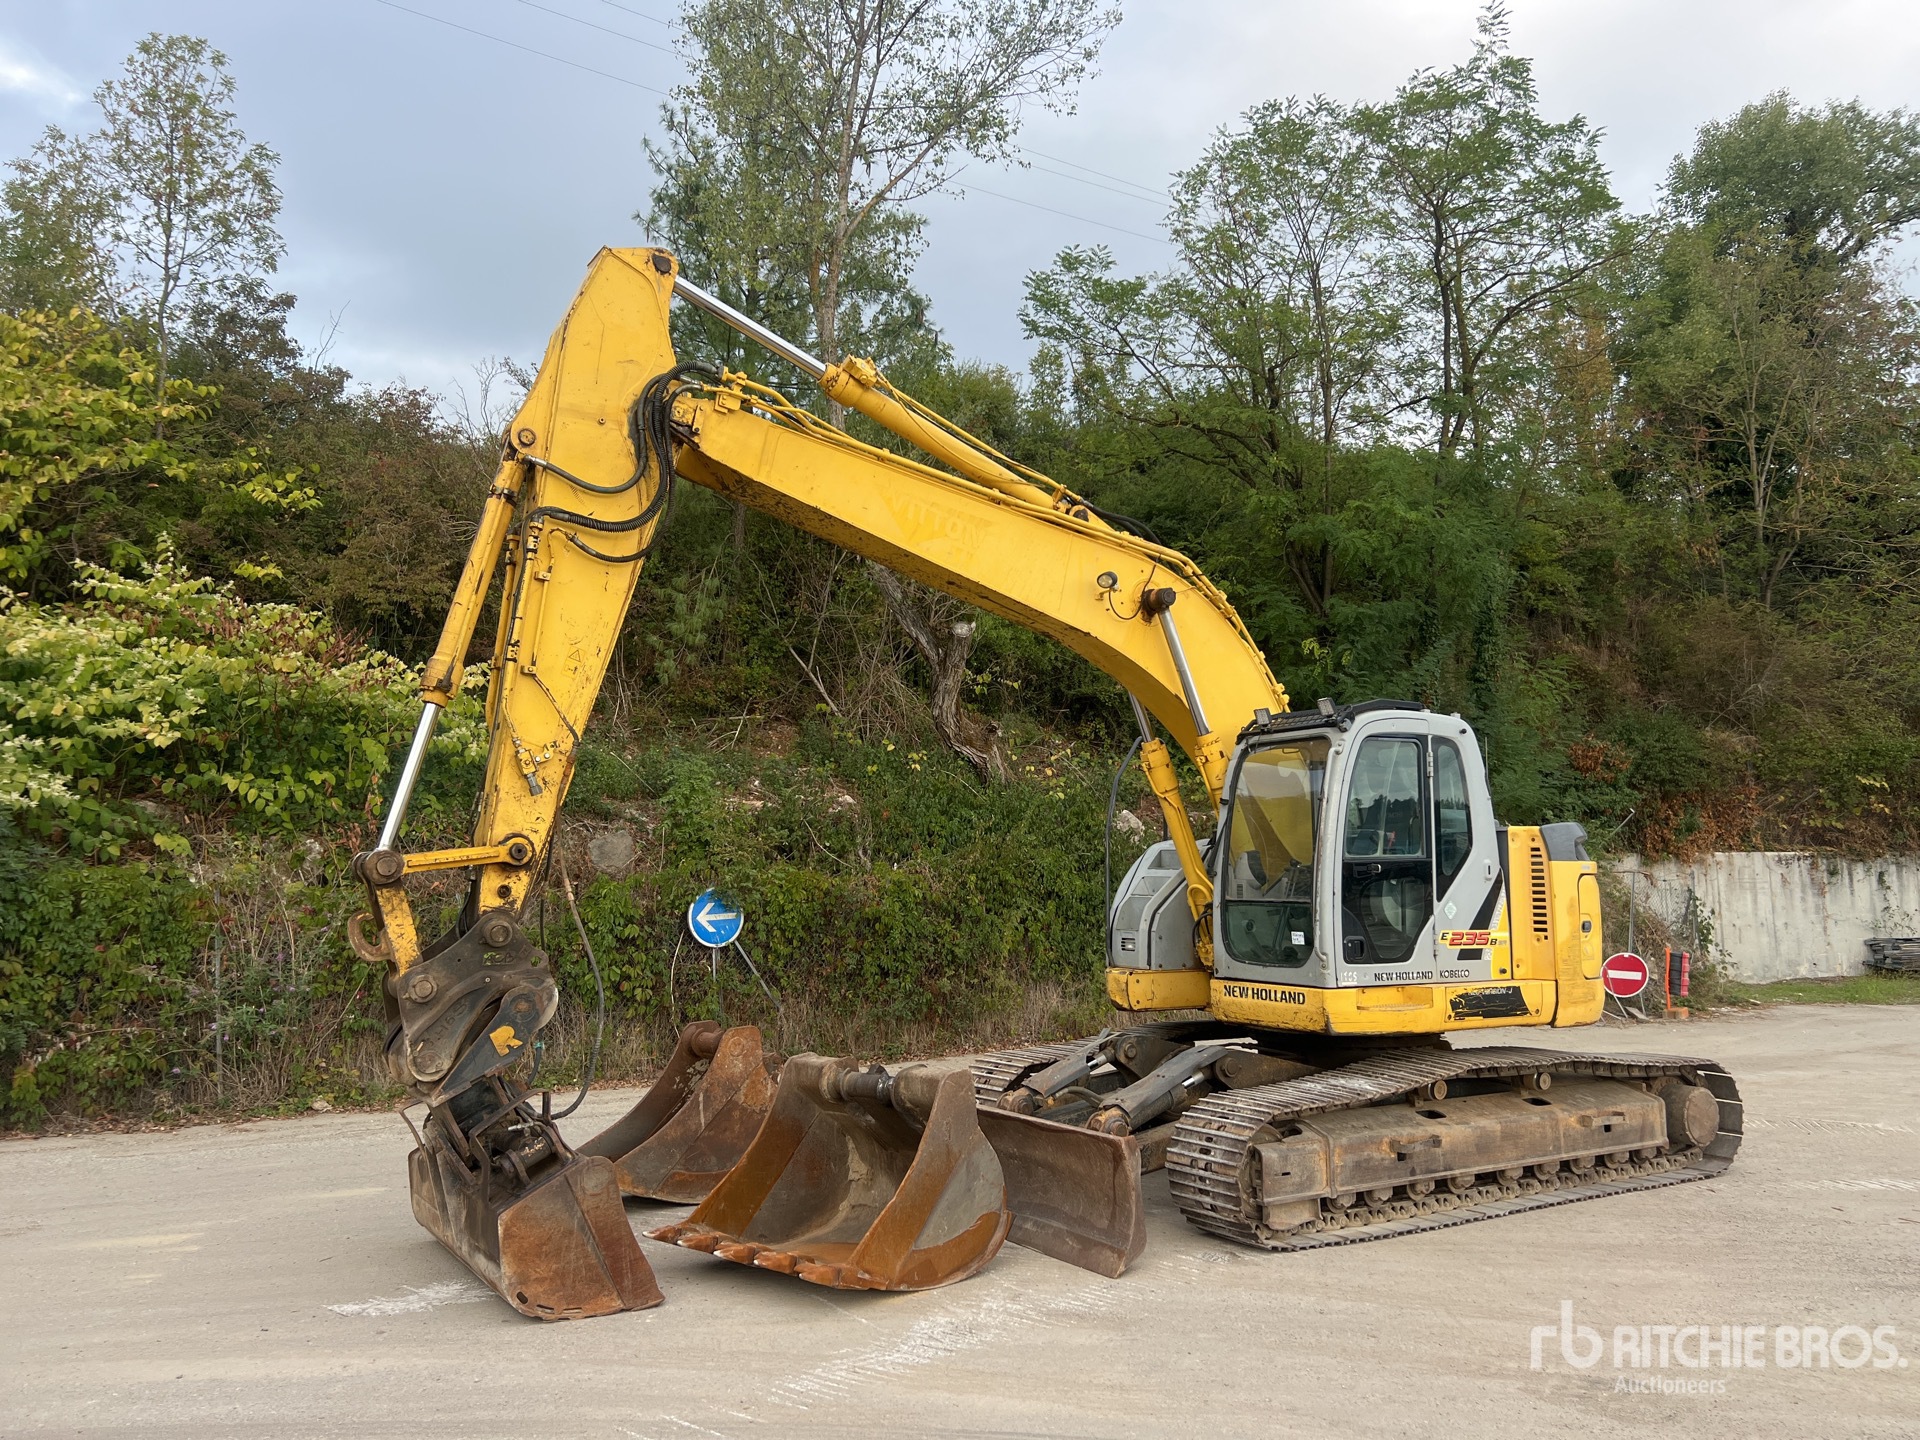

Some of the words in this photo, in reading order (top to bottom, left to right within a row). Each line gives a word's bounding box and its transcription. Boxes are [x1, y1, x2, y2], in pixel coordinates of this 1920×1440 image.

[1374, 972, 1393, 981] NEW
[1396, 970, 1433, 980] HOLLAND
[1440, 969, 1469, 978] KOBELCO
[1224, 984, 1248, 998] NEW
[1252, 987, 1306, 1005] HOLLAND
